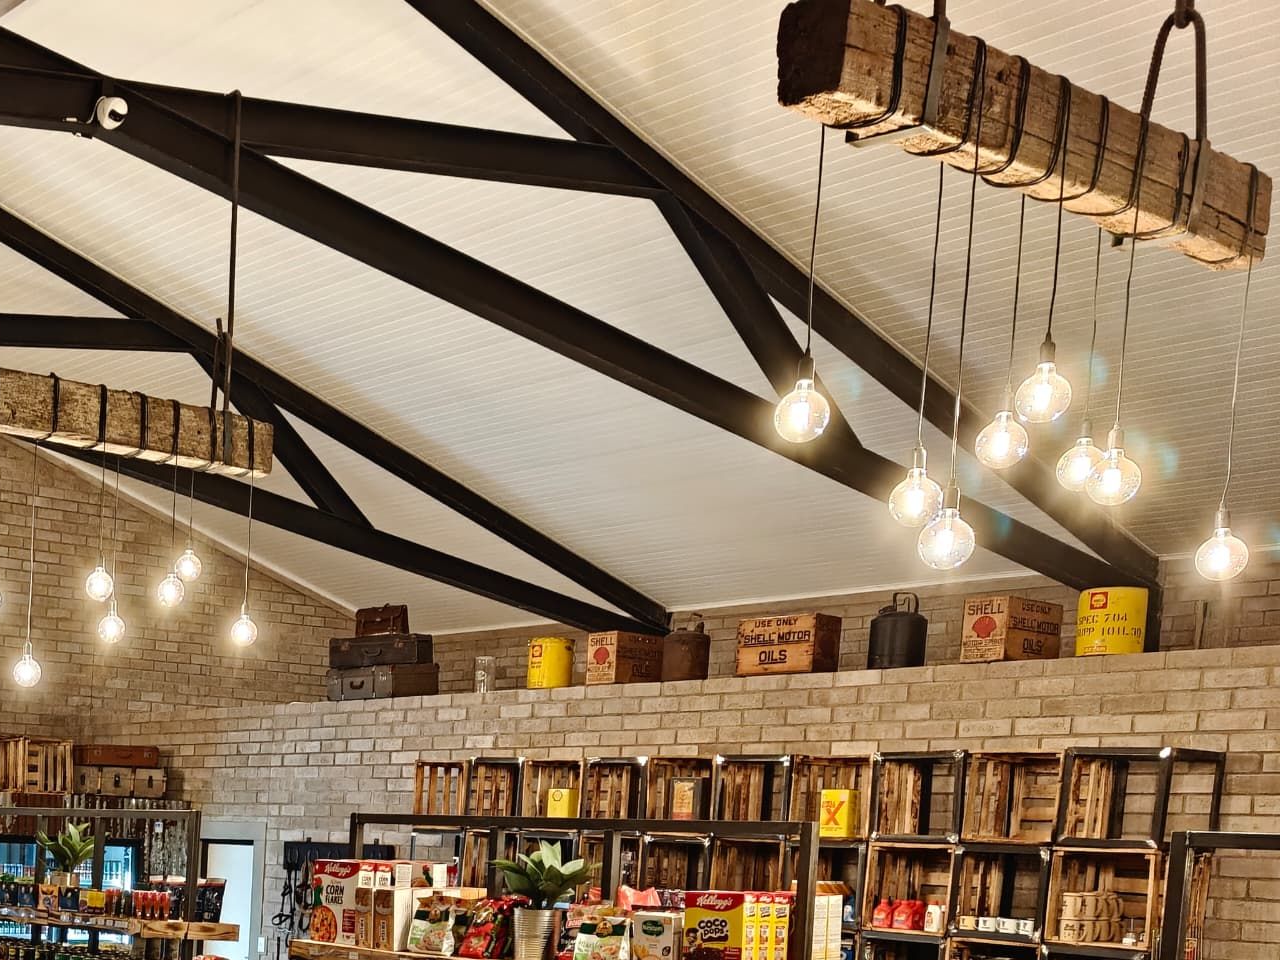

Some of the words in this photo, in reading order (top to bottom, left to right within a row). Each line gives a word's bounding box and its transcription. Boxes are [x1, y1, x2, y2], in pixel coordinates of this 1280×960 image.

[967, 602, 1004, 616] SHELL
[754, 620, 773, 629] USE
[776, 617, 799, 627] ONLY
[590, 636, 616, 647] SHELL
[777, 630, 811, 642] MOTOR
[758, 650, 788, 663] OILS
[324, 862, 352, 877] Kellogg's
[325, 884, 345, 895] CORN
[325, 895, 344, 905] FLAKES
[696, 893, 733, 911] Kellogg's
[698, 918, 728, 930] COCO
